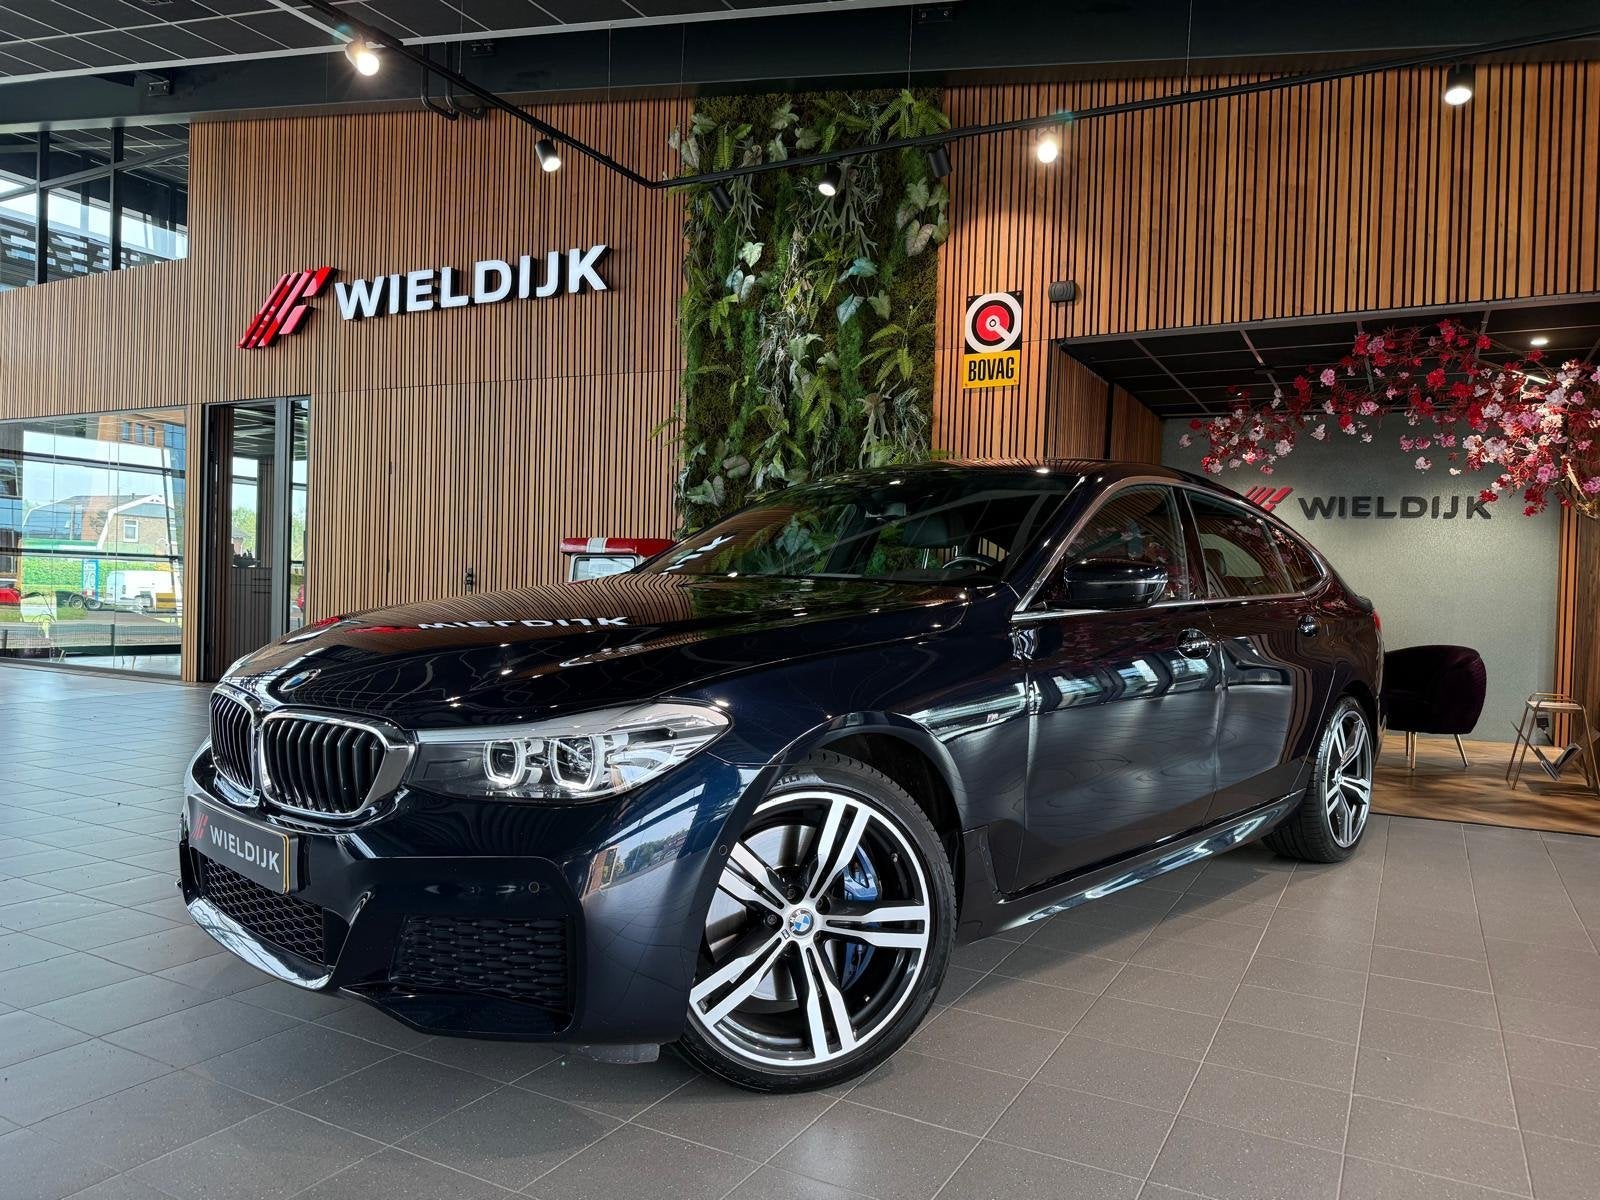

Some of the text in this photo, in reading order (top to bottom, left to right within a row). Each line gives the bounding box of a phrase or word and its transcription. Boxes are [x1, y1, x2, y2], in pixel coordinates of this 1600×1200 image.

[335, 244, 609, 321] WIELDIJK
[968, 356, 1015, 382] BOVAG
[1298, 495, 1492, 521] WIELDIJK
[210, 824, 280, 874] WIELDIJK
